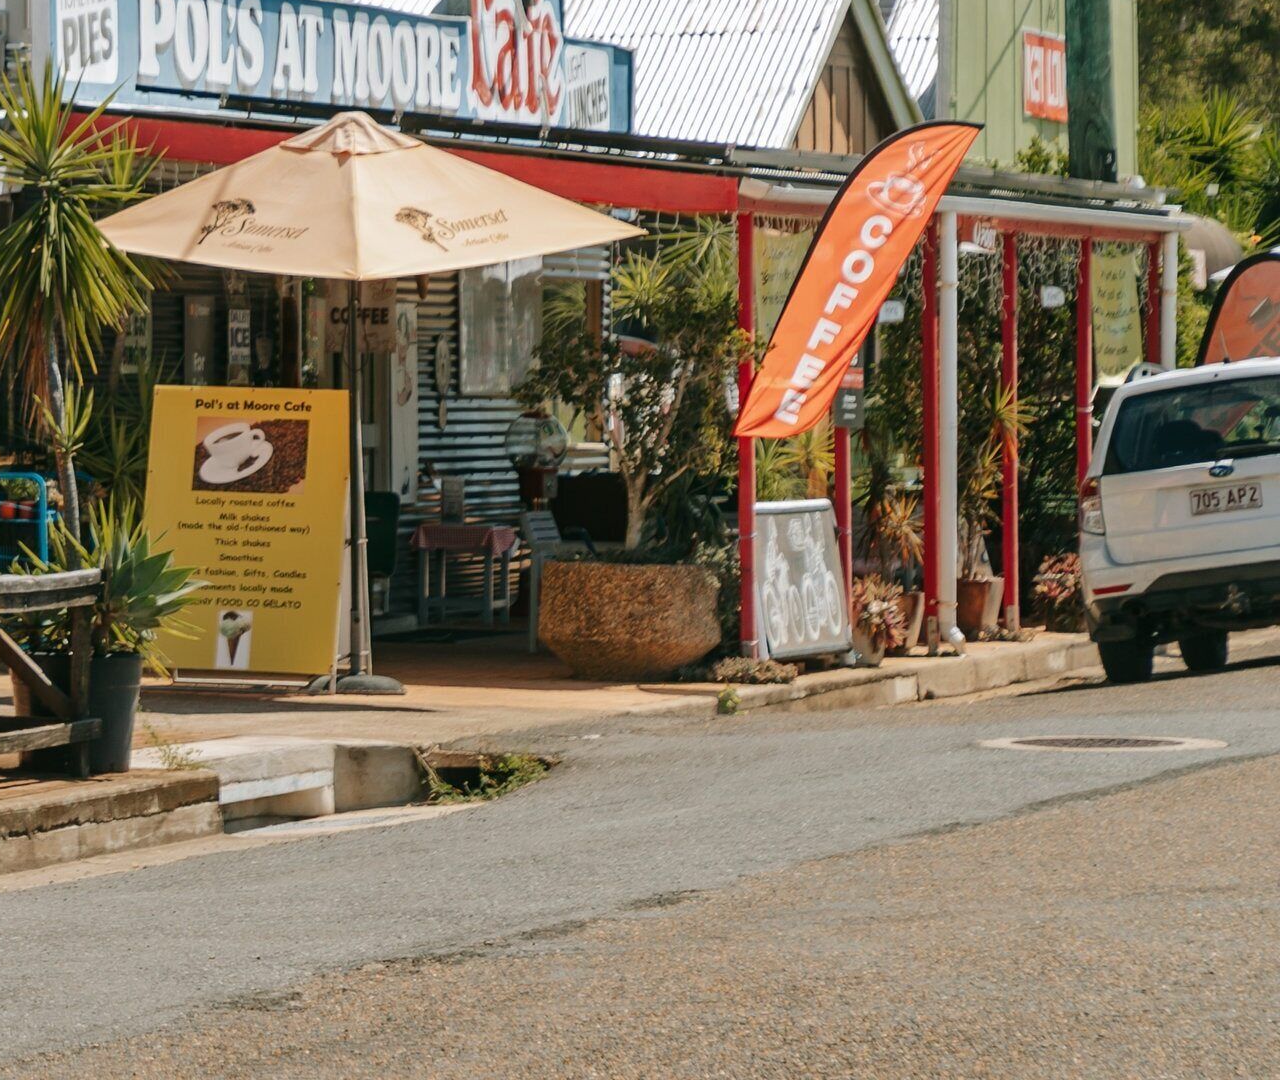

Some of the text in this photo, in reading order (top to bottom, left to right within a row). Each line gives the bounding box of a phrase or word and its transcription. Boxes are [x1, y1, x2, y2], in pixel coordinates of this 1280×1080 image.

[62, 7, 114, 71] PIES
[274, 1, 325, 95] AT
[333, 8, 462, 114] MOORE
[220, 218, 310, 241] Somerset
[436, 208, 510, 240] Somerset
[774, 214, 894, 425] COFFEE
[230, 327, 251, 347] ICE
[195, 398, 312, 412] Pol's at Moore Cafe
[195, 496, 296, 508] Locally roasted coffee
[1193, 486, 1259, 511] 705 AP2
[219, 512, 271, 522] Milk shakes
[177, 521, 311, 535] (made the old-fashioned way)
[214, 538, 271, 548] Thick shakes
[218, 553, 264, 562] Smoothies
[273, 570, 307, 579] Candles
[239, 584, 268, 594] locally
[270, 585, 293, 594] made
[216, 597, 244, 607] FOOD
[246, 598, 260, 607] CO
[263, 598, 302, 609] GELATO
